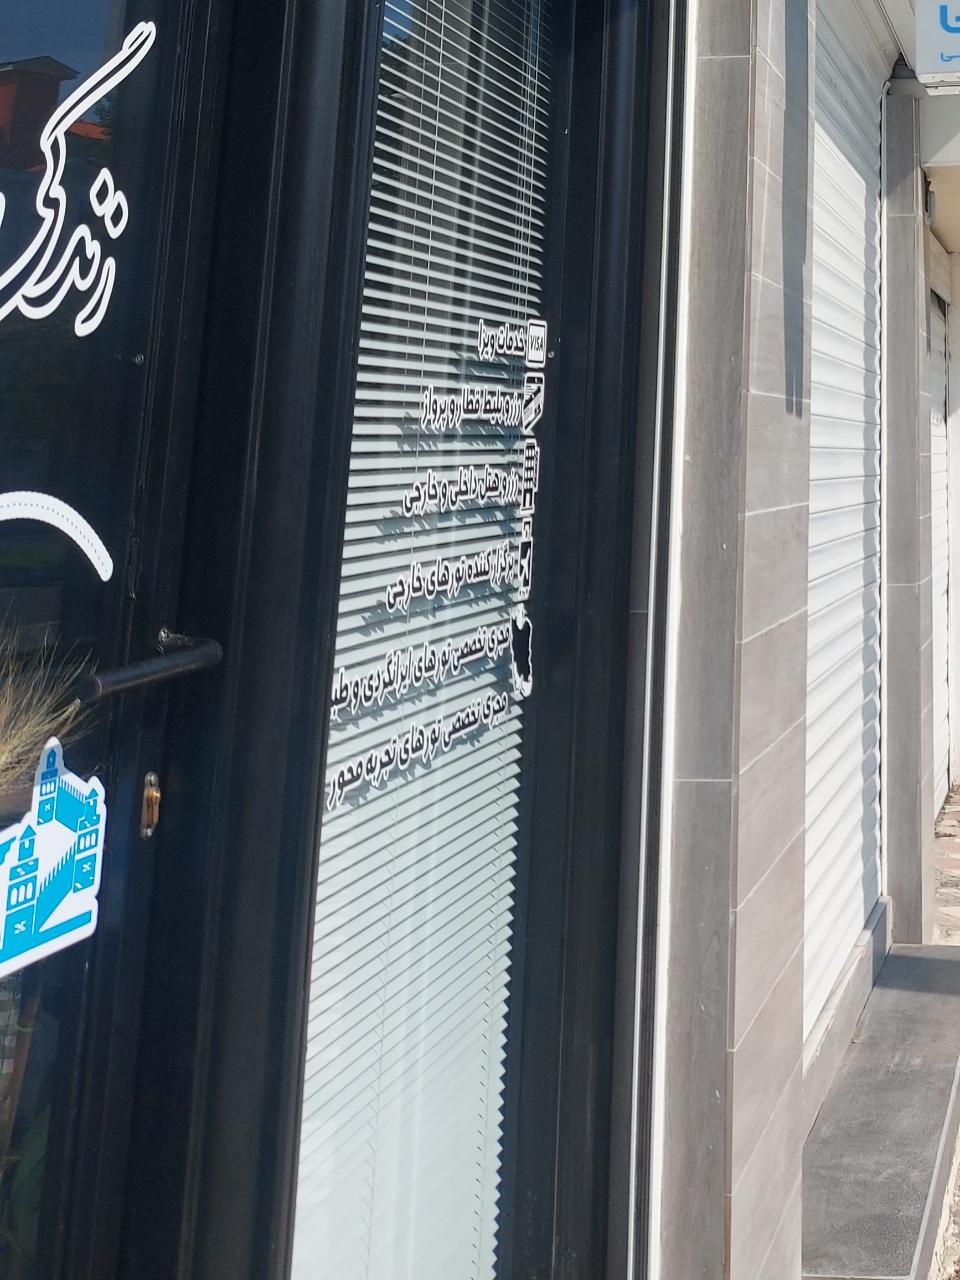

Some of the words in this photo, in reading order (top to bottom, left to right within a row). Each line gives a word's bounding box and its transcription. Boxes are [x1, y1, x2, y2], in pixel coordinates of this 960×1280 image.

[478, 319, 496, 361] ویزا
[495, 322, 525, 355] خدمات
[530, 335, 543, 352] VISA
[421, 384, 449, 431] پرواز
[456, 385, 481, 428] قطار
[481, 386, 503, 424] بلیط
[502, 392, 521, 426] رزرو
[402, 469, 440, 517] خارجی
[440, 479, 449, 512] و
[448, 465, 479, 510] داخلی
[479, 464, 500, 500] هتل
[500, 467, 519, 502] رزرو
[490, 540, 515, 587] برگزار
[385, 561, 424, 613] خارجی
[451, 627, 487, 675] تخصصی
[487, 624, 511, 660] مجری
[351, 676, 361, 715] و
[482, 692, 508, 729] مجری
[443, 698, 482, 752] تخصصی
[364, 734, 399, 786] تجربه
[326, 758, 364, 812] محور
